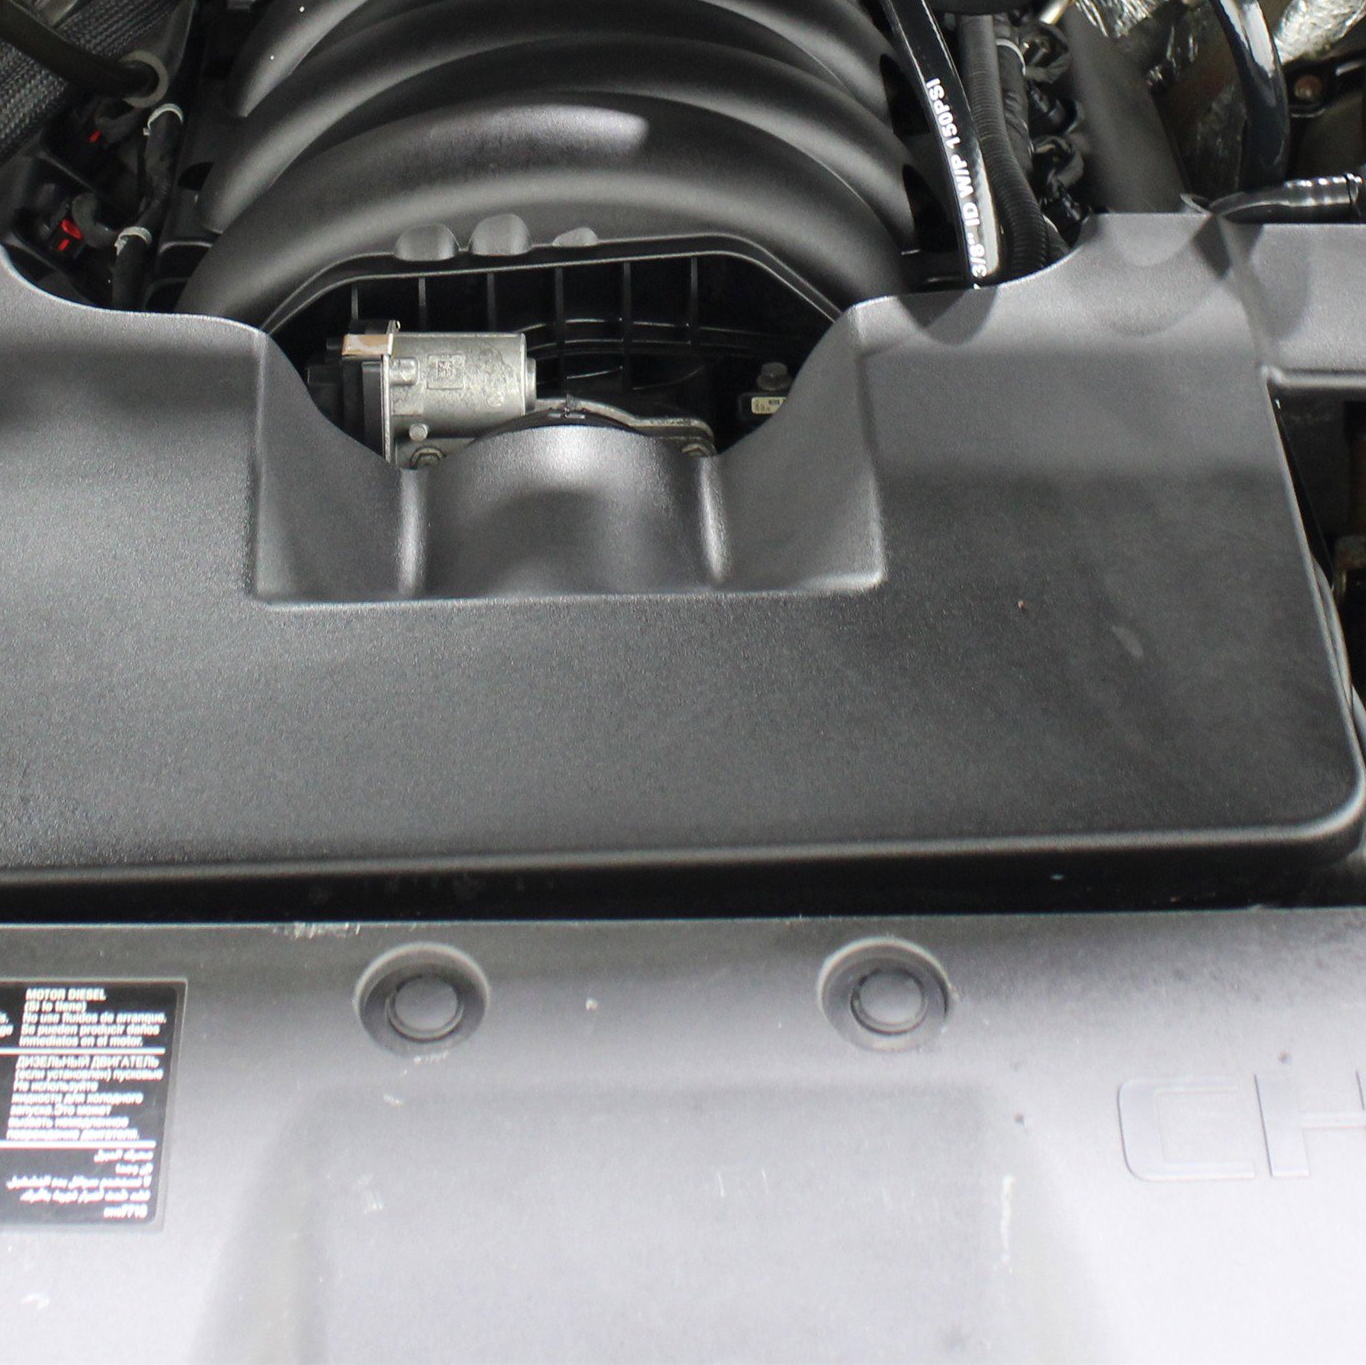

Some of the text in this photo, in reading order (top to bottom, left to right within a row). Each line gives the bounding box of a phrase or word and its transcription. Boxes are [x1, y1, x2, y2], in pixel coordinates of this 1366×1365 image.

[925, 77, 961, 149] 150PSI
[950, 154, 974, 199] W/P
[962, 202, 980, 227] ID
[25, 988, 107, 1001] MOTOR DIESEL
